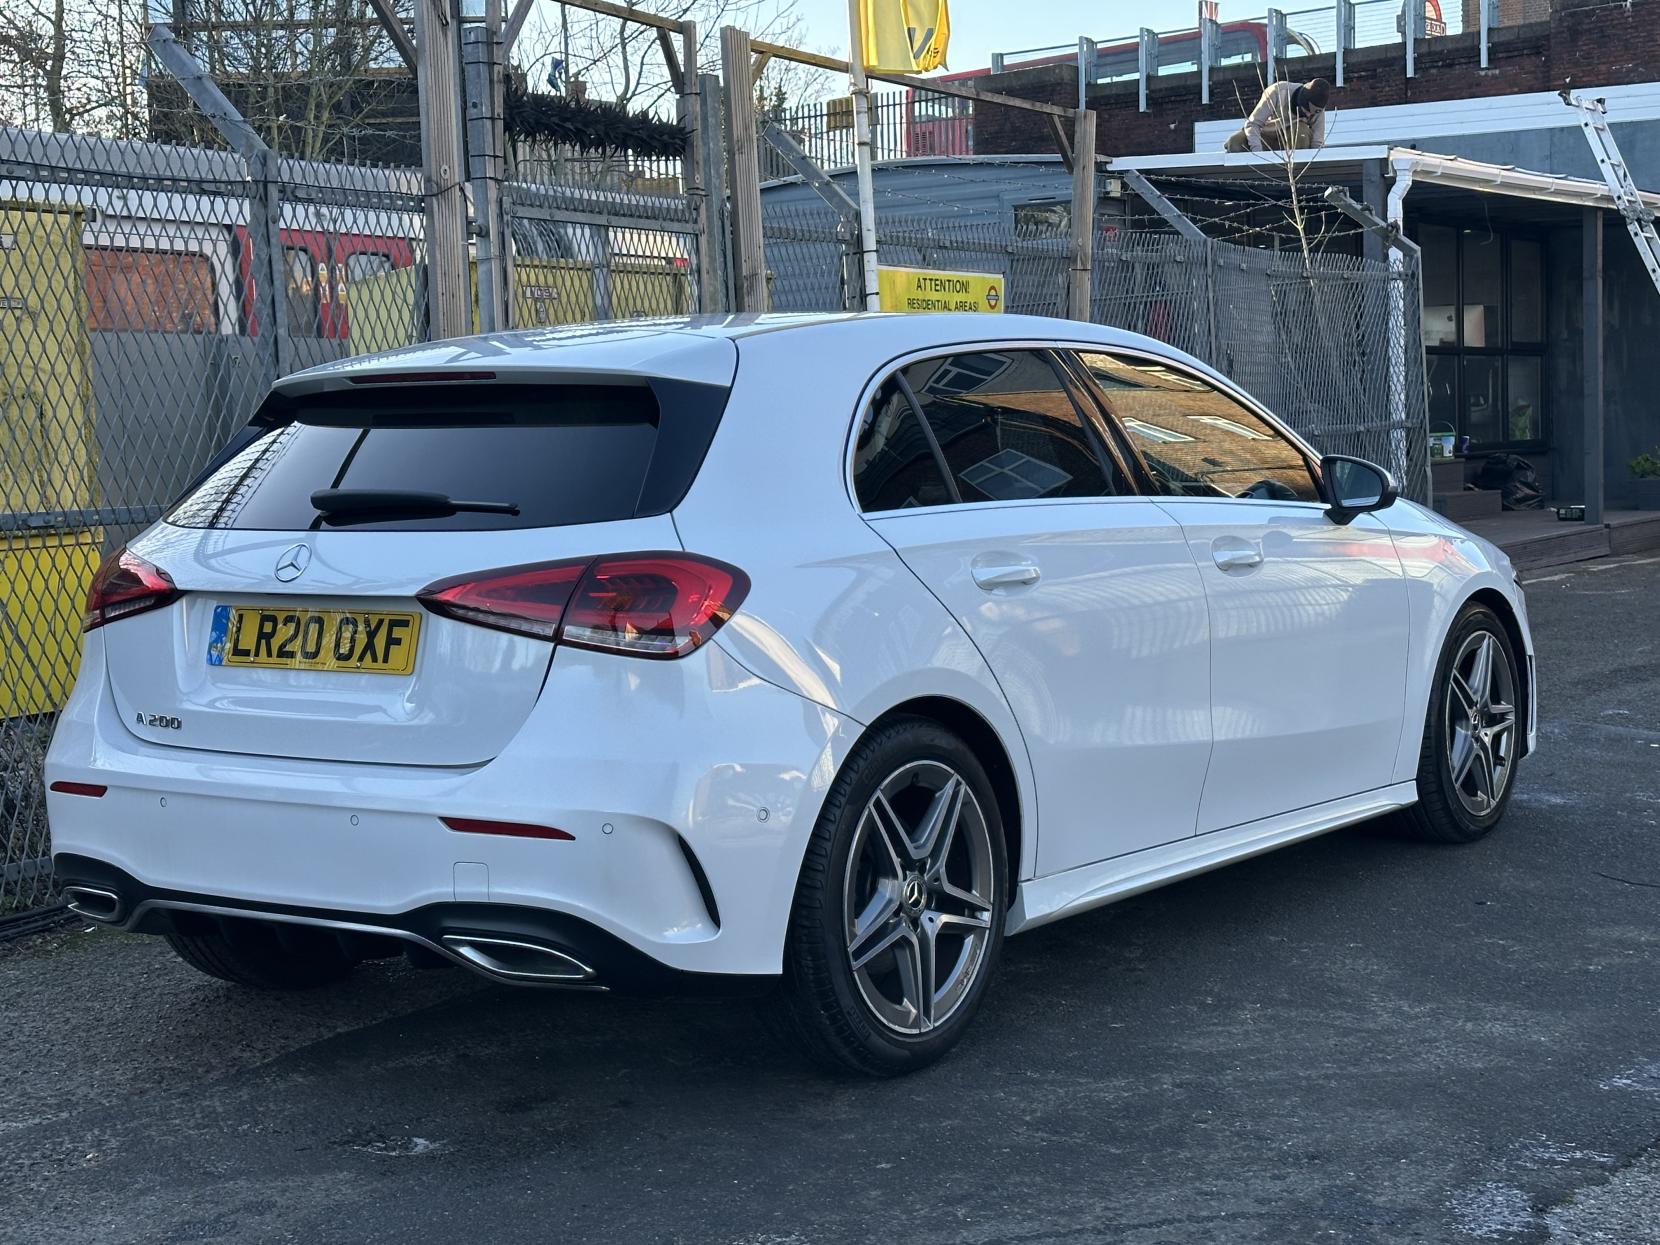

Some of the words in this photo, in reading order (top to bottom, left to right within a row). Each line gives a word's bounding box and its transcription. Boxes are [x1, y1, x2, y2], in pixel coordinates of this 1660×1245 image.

[916, 277, 970, 294] ATTENTION!
[906, 298, 952, 312] RESIDENTIAL
[954, 300, 979, 313] AREAS!
[231, 613, 325, 660] LR20
[333, 616, 411, 664] OXF
[136, 711, 147, 725] A
[148, 713, 182, 730] 200
